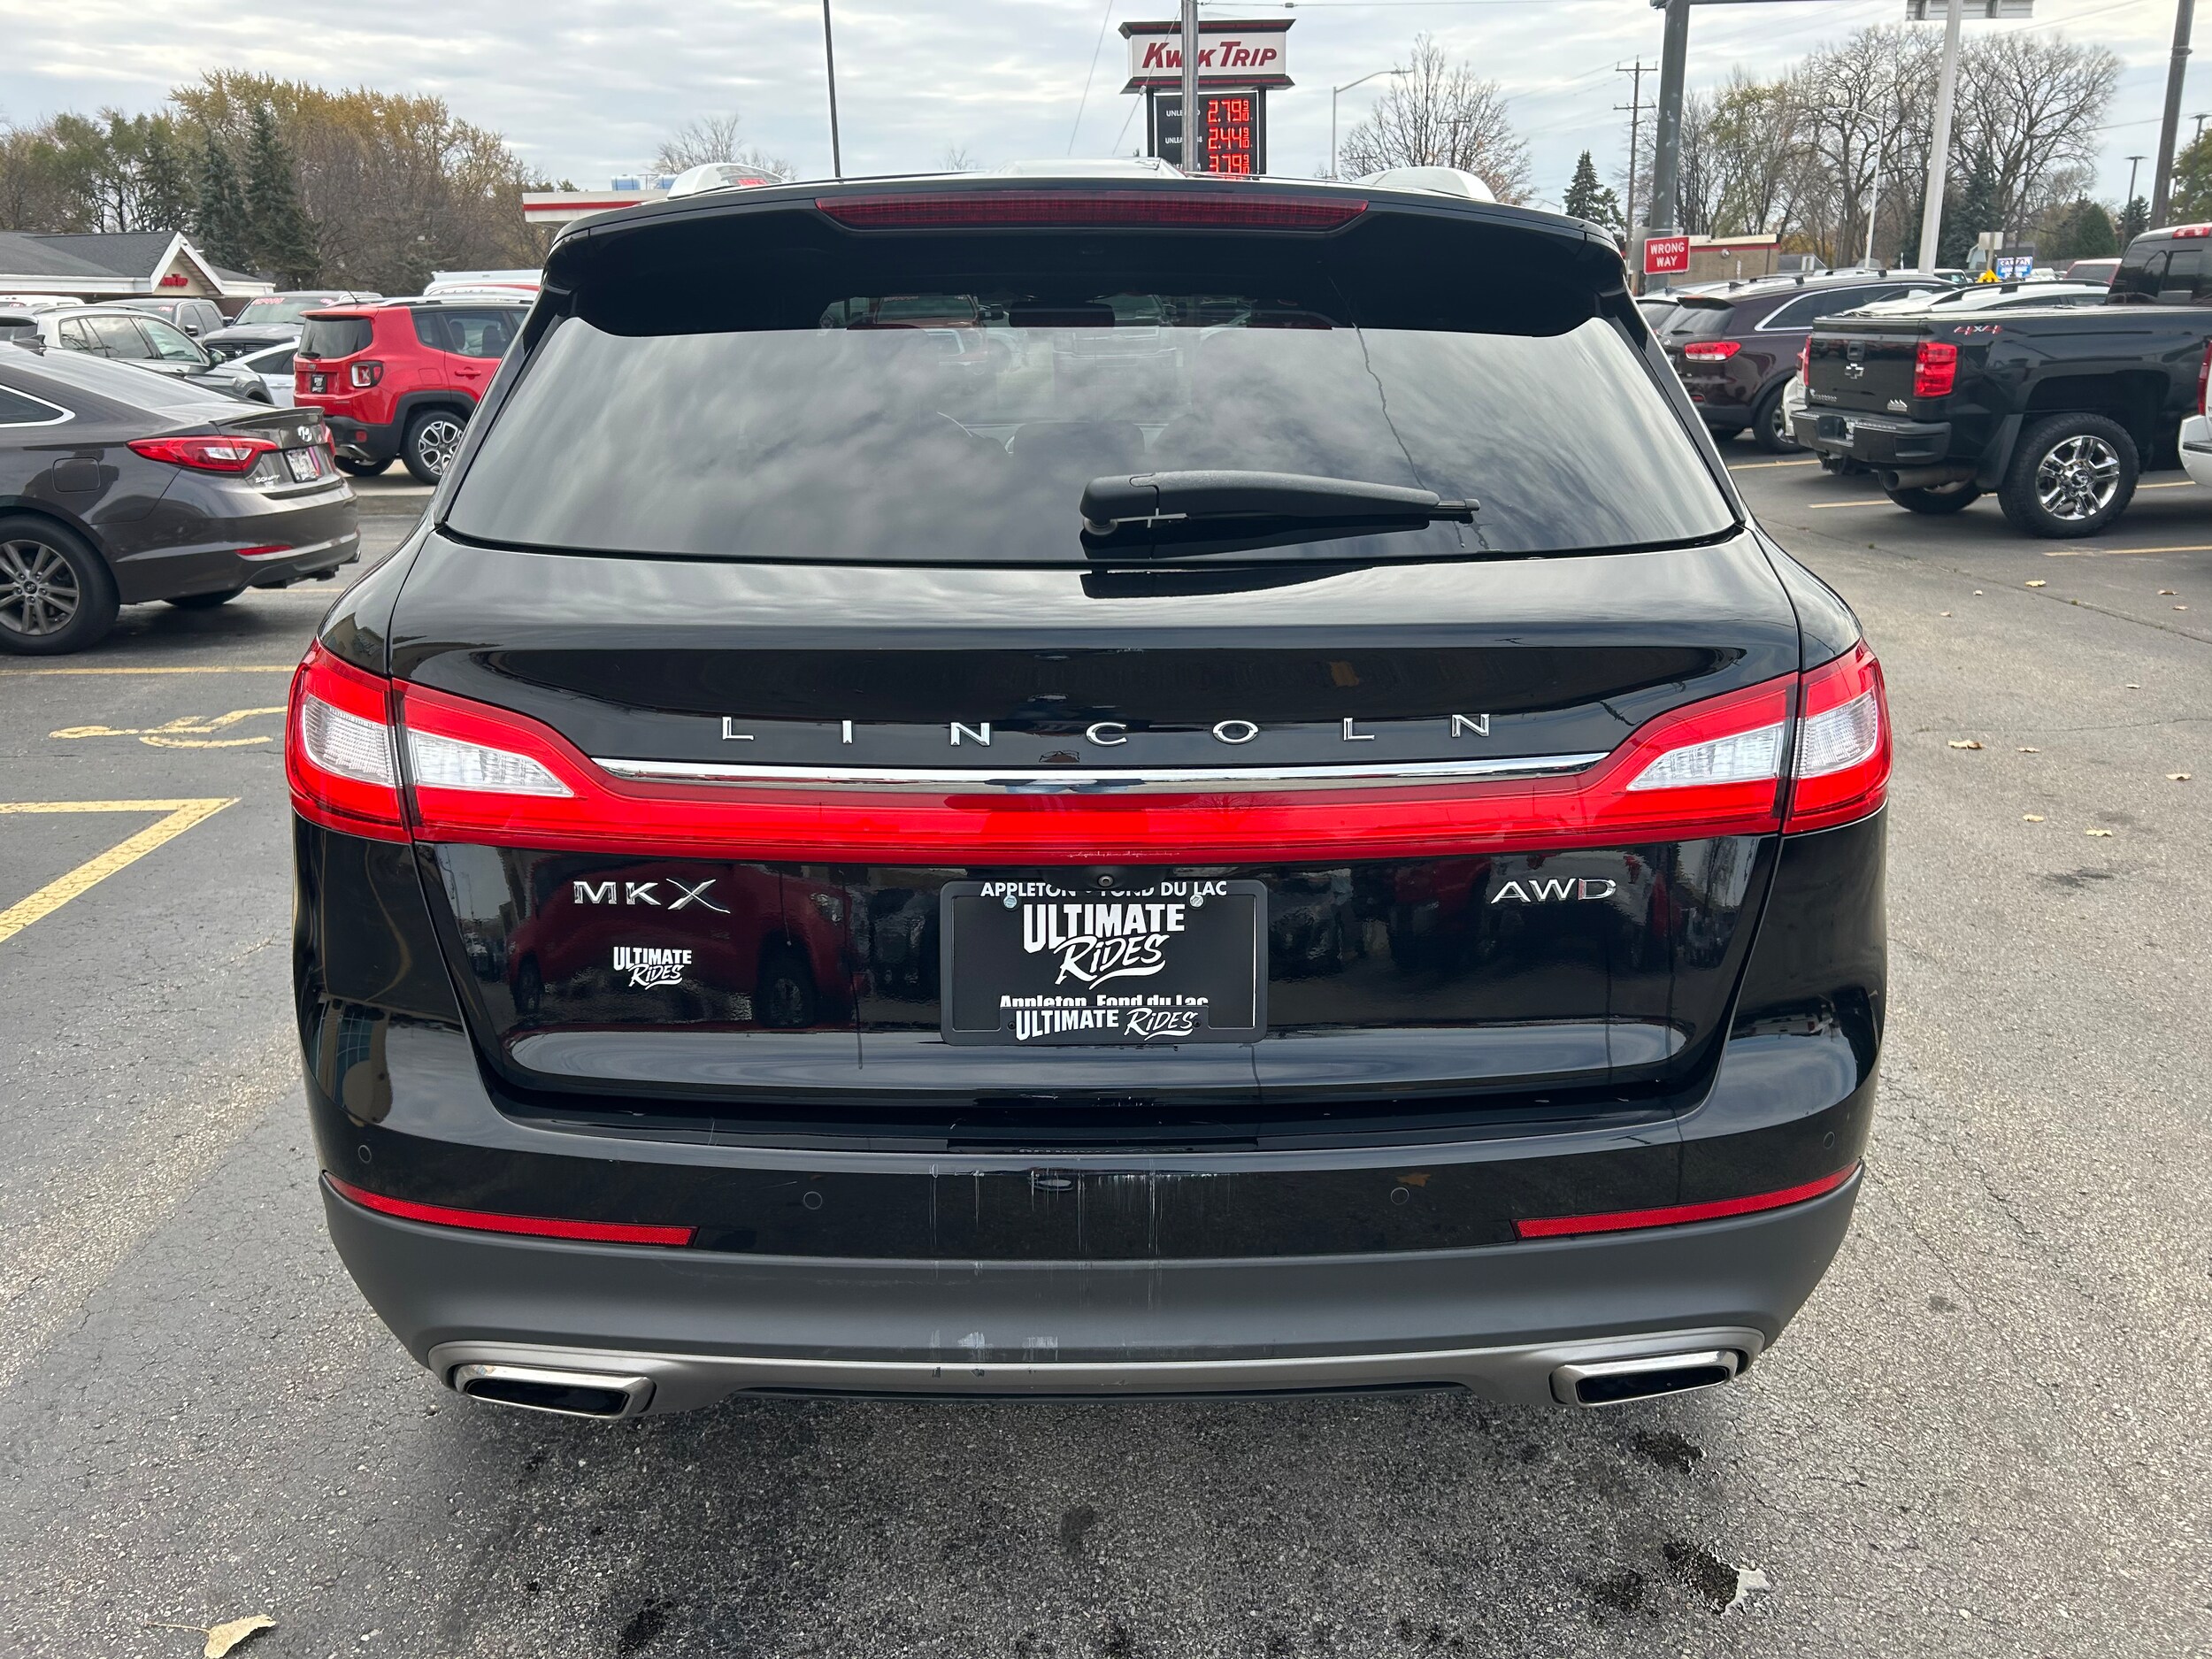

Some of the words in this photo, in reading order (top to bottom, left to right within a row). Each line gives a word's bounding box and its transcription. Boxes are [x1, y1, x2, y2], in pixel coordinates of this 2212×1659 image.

[1142, 42, 1217, 68] KWK
[1220, 42, 1277, 67] TRIP
[1650, 242, 1685, 255] WRONG
[1656, 256, 1678, 267] WAY
[722, 714, 1490, 747] LINCOLN
[573, 878, 731, 914] MKX
[1161, 881, 1187, 896] DU
[1194, 881, 1227, 896] LAC
[1491, 878, 1617, 904] AWD
[1023, 903, 1186, 954] ULTIMATE
[613, 947, 692, 972] ULTIMATE
[1016, 1010, 1119, 1041] ULTIMATE
